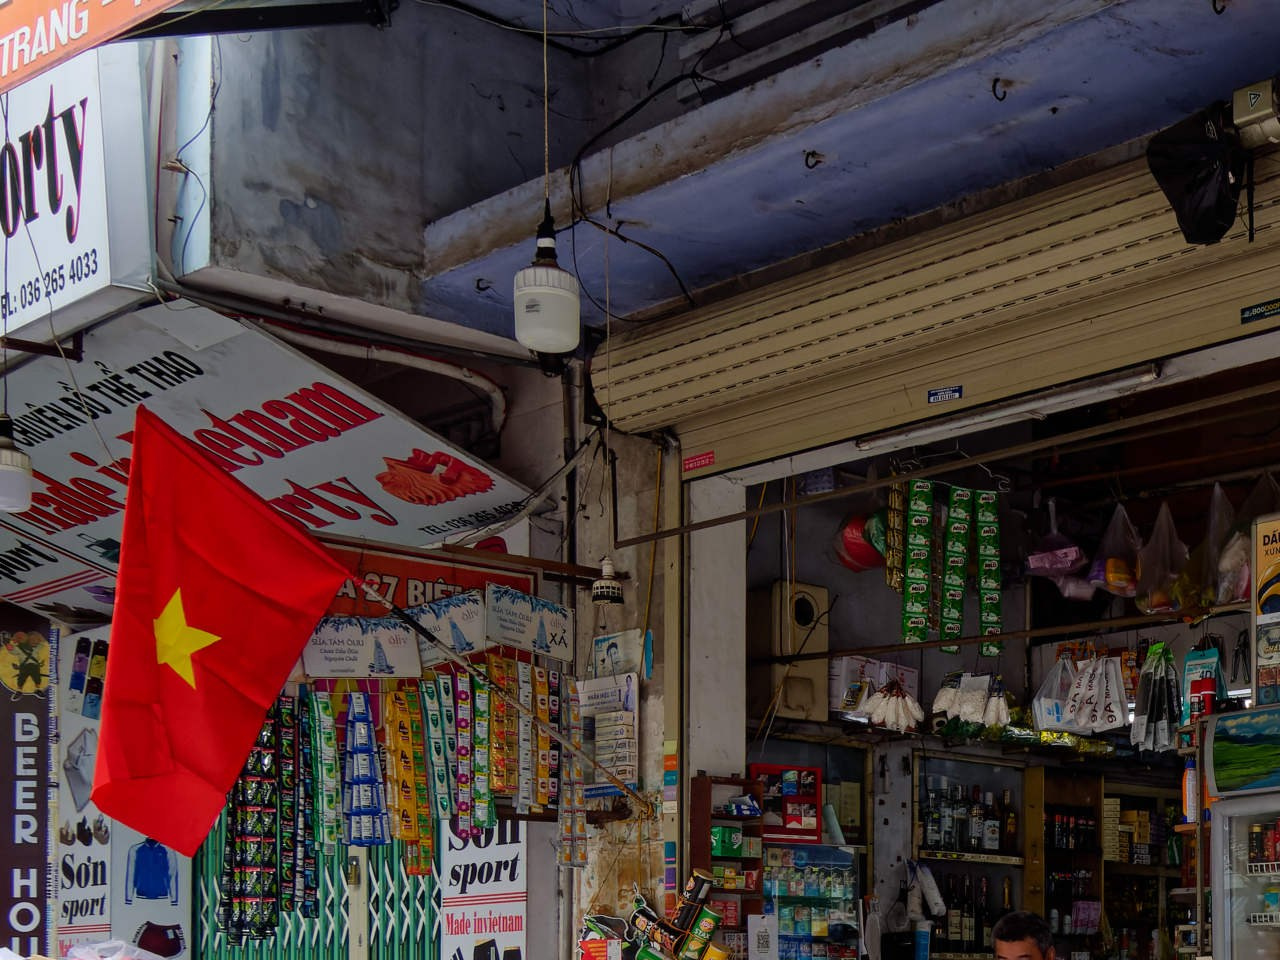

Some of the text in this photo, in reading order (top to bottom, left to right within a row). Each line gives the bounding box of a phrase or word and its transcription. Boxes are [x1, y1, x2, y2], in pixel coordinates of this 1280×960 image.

[20, 248, 98, 309] 036 265 4033
[125, 350, 204, 391] THAO
[267, 477, 398, 530] rty
[418, 516, 450, 536] TEL:
[13, 712, 40, 845] BEER
[450, 850, 521, 895] sport
[60, 894, 106, 926] sport
[445, 911, 471, 936] Made
